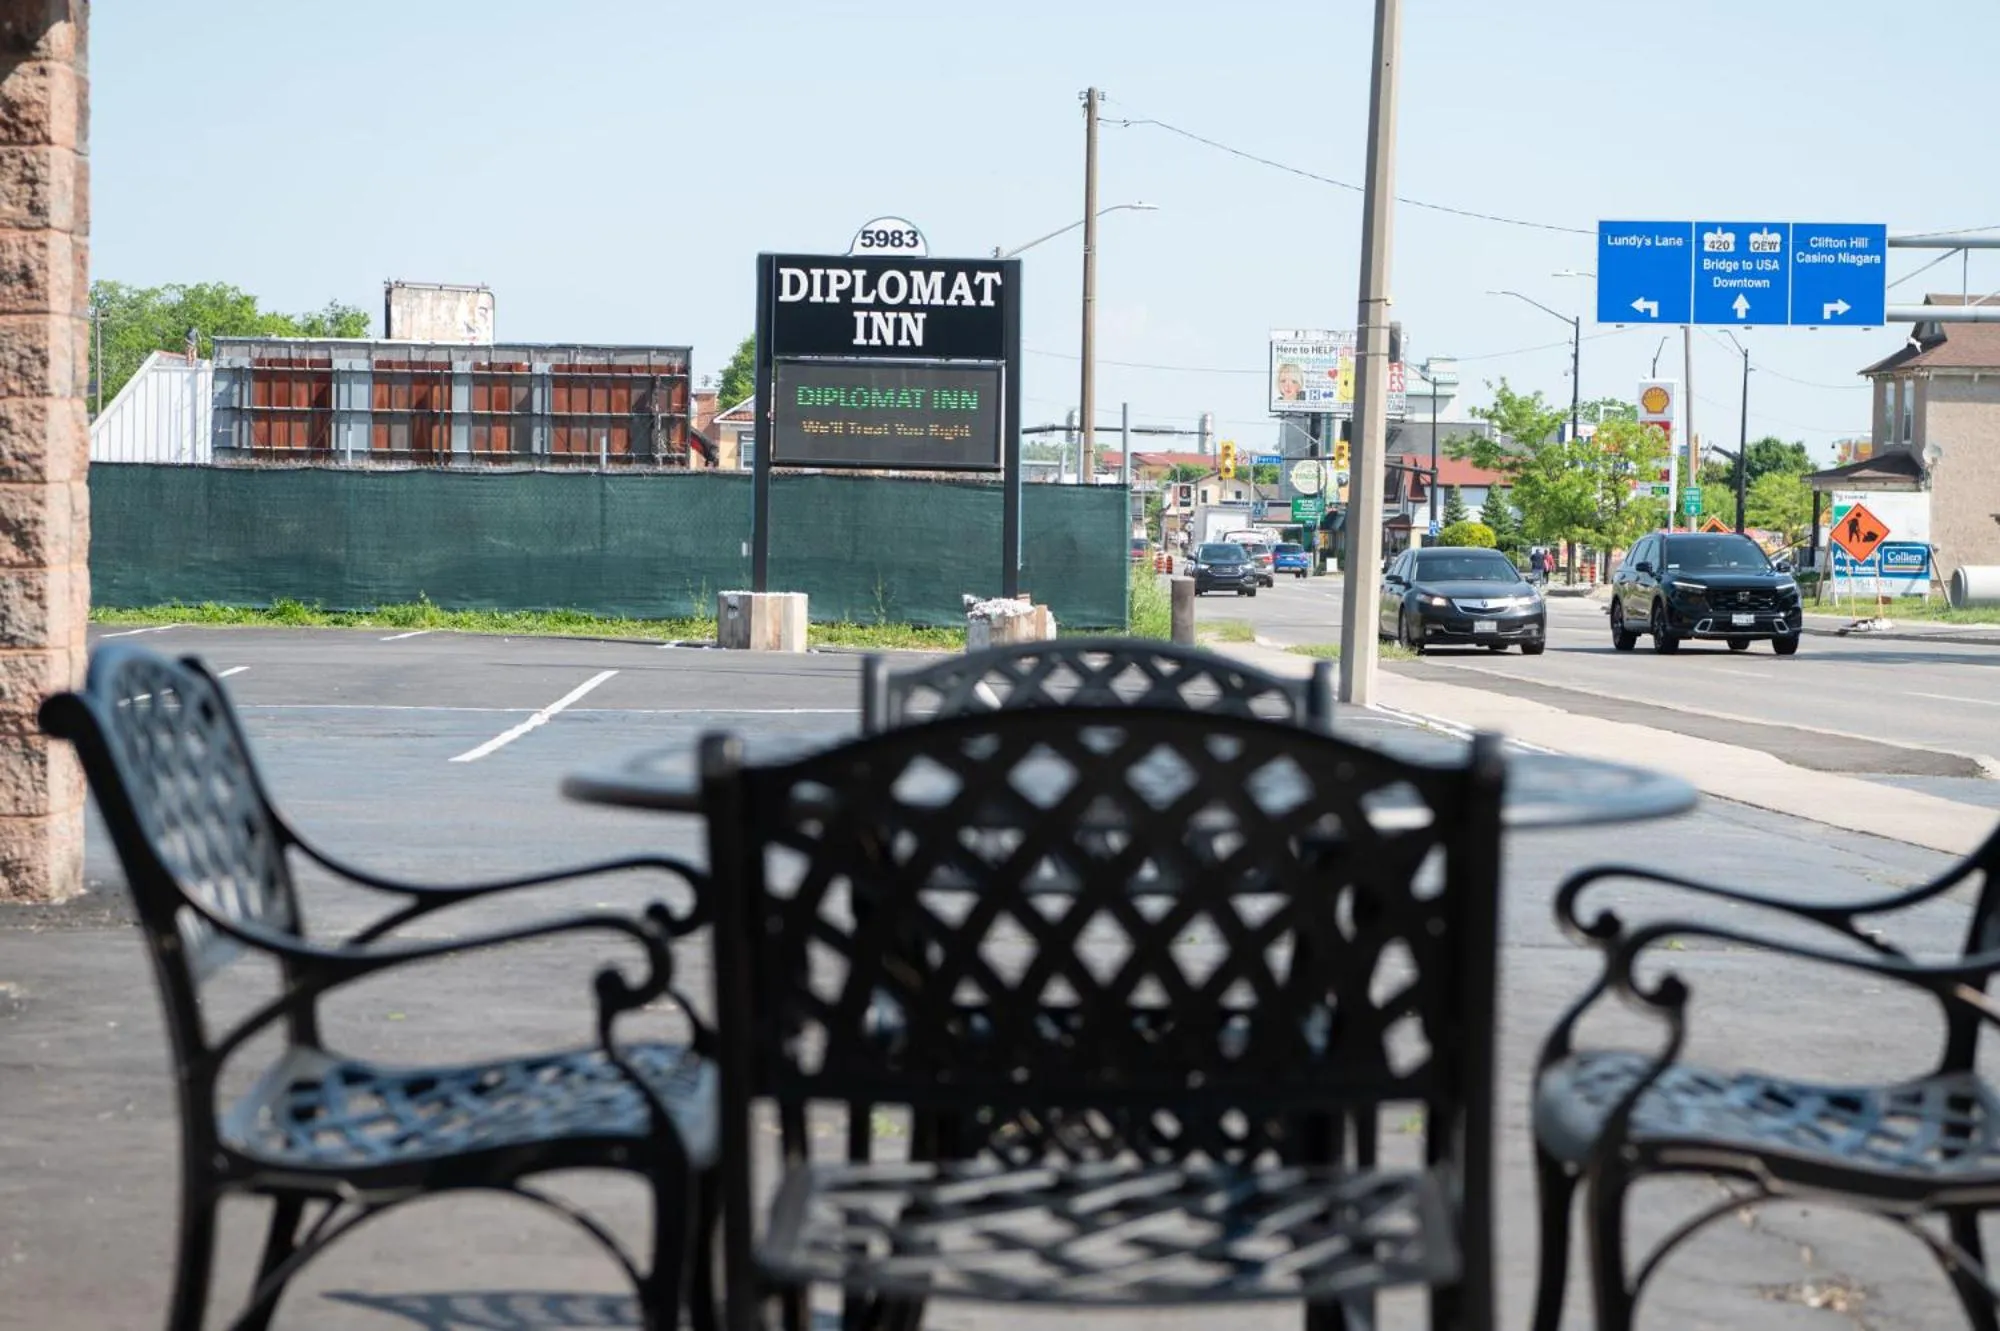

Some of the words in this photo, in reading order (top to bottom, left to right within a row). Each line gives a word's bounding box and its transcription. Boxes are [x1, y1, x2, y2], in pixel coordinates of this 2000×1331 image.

[860, 229, 919, 249] 5983
[1607, 234, 1652, 249] Lundy's
[1655, 234, 1684, 247] Lane
[1708, 240, 1730, 251] 420
[1752, 240, 1779, 251] QEW
[1809, 236, 1847, 249] Clifton
[1850, 236, 1869, 249] Hill
[1703, 258, 1739, 273] Bridge
[1742, 259, 1753, 271] to
[1756, 258, 1780, 271] USA
[1796, 251, 1836, 264] Casino
[1838, 252, 1881, 267] Niagara
[778, 267, 1002, 307] DIPLOMAT
[1713, 276, 1771, 288] Downtown
[853, 311, 927, 346] INN
[1276, 345, 1298, 353] Here
[1300, 345, 1309, 353] to
[797, 386, 927, 409] DIPLOMAT
[932, 389, 979, 409] INN
[848, 422, 890, 435] Treat
[895, 423, 925, 436] You
[929, 424, 972, 441] Right
[1887, 551, 1922, 562] Colliers
